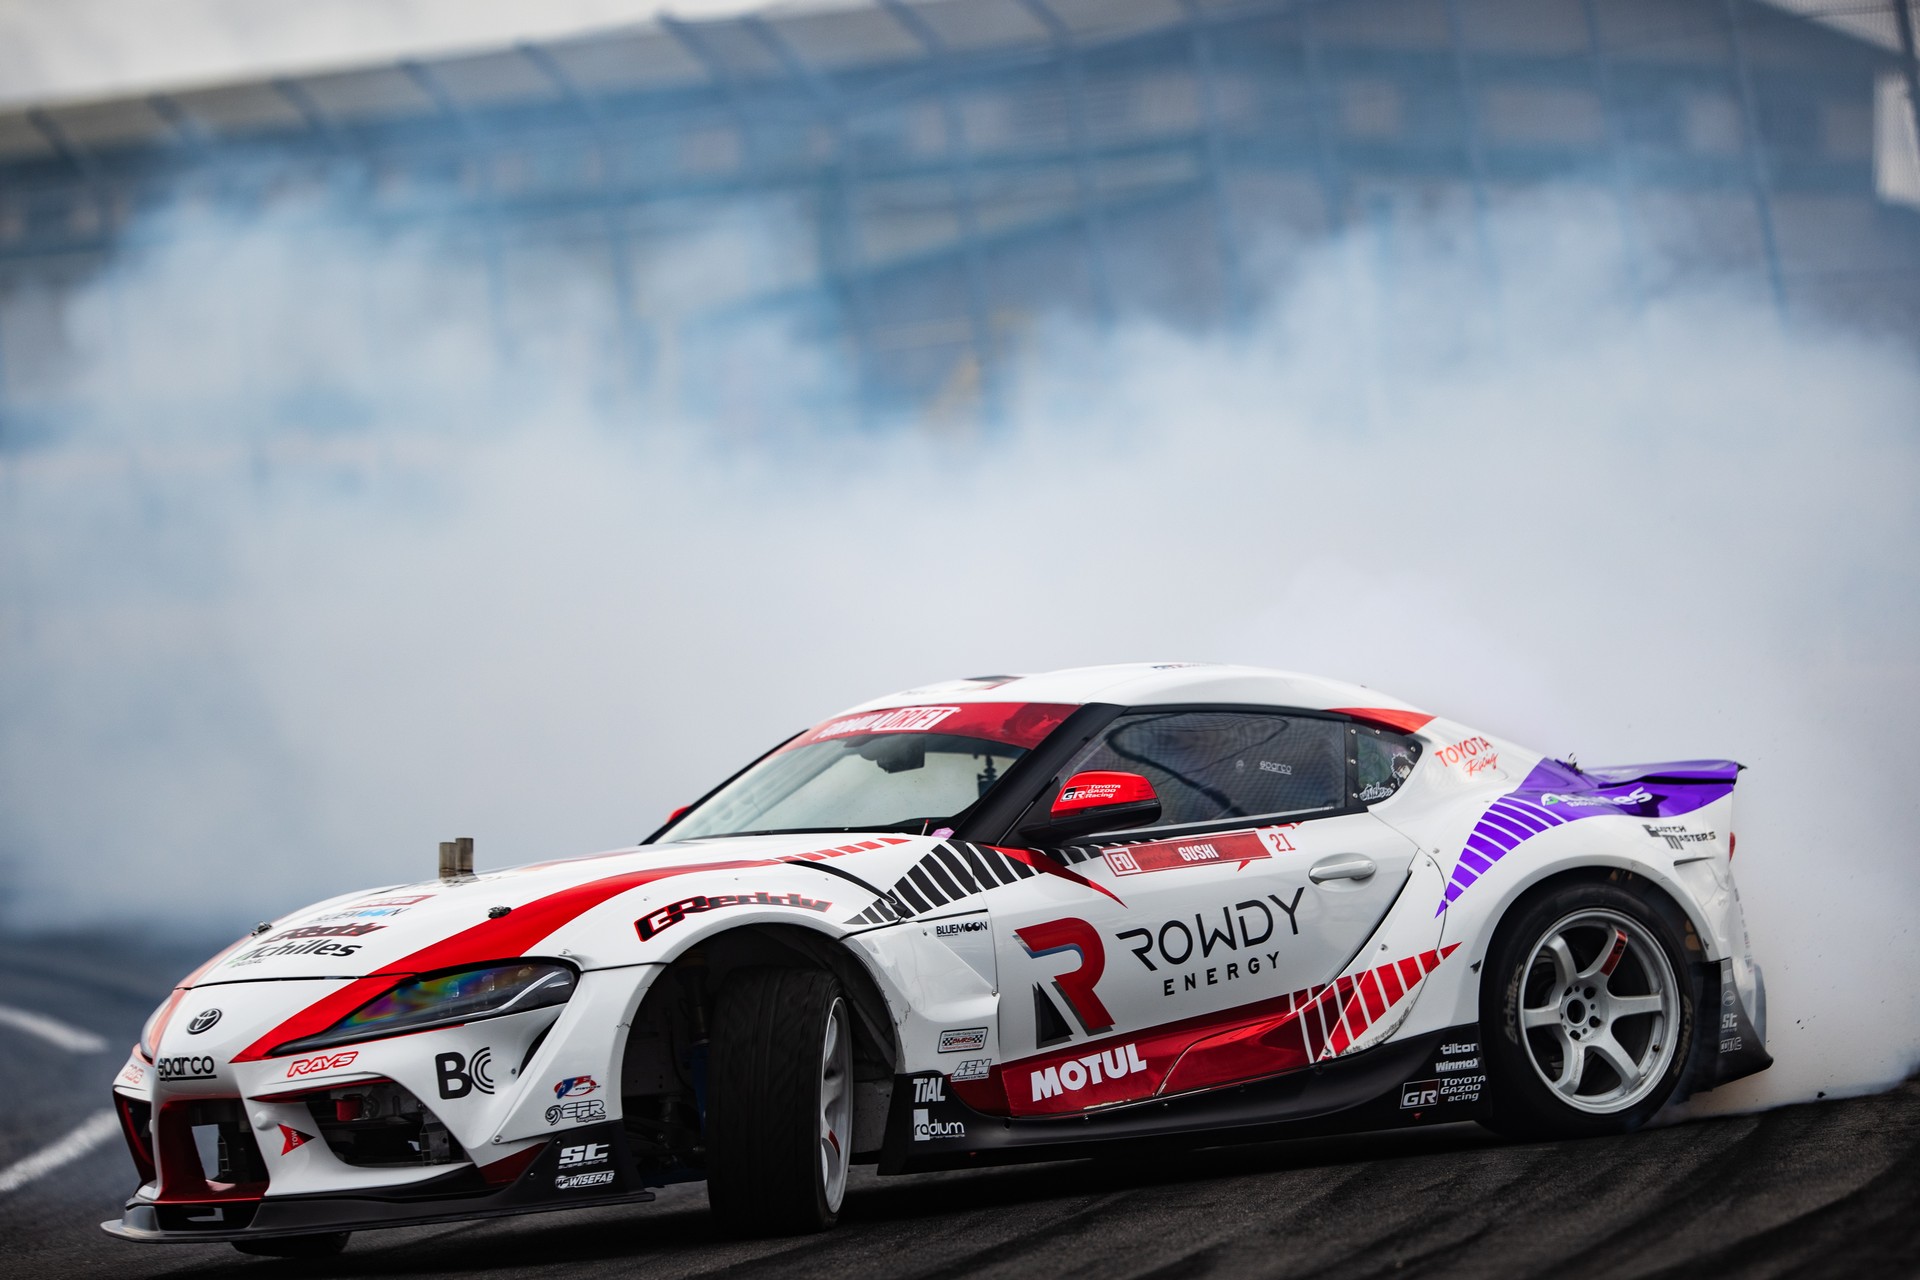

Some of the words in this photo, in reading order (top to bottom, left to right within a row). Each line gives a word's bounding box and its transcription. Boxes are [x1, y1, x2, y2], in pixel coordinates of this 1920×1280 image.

[1434, 736, 1494, 767] TOYOTA
[1259, 760, 1292, 775] sparco
[1063, 790, 1085, 801] GR
[1662, 831, 1716, 850] MASTERS
[1111, 852, 1134, 871] FD
[1177, 844, 1219, 862] GUSHI
[1269, 833, 1296, 852] 21
[936, 921, 988, 935] BLUEMOON
[1115, 887, 1305, 972] ROWDY
[1163, 951, 1280, 996] ENERGY
[158, 1055, 215, 1083] sparco
[287, 1051, 358, 1078] RAYS
[952, 1058, 992, 1077] AEM
[1031, 1043, 1147, 1102] MOTUL
[1440, 1084, 1481, 1095] GAZOO
[1442, 1075, 1486, 1087] TOYOTA
[1403, 1090, 1437, 1106] GR
[914, 1118, 965, 1136] radium
[291, 1129, 299, 1147] TOW
[569, 1172, 615, 1187] WISEFAB
